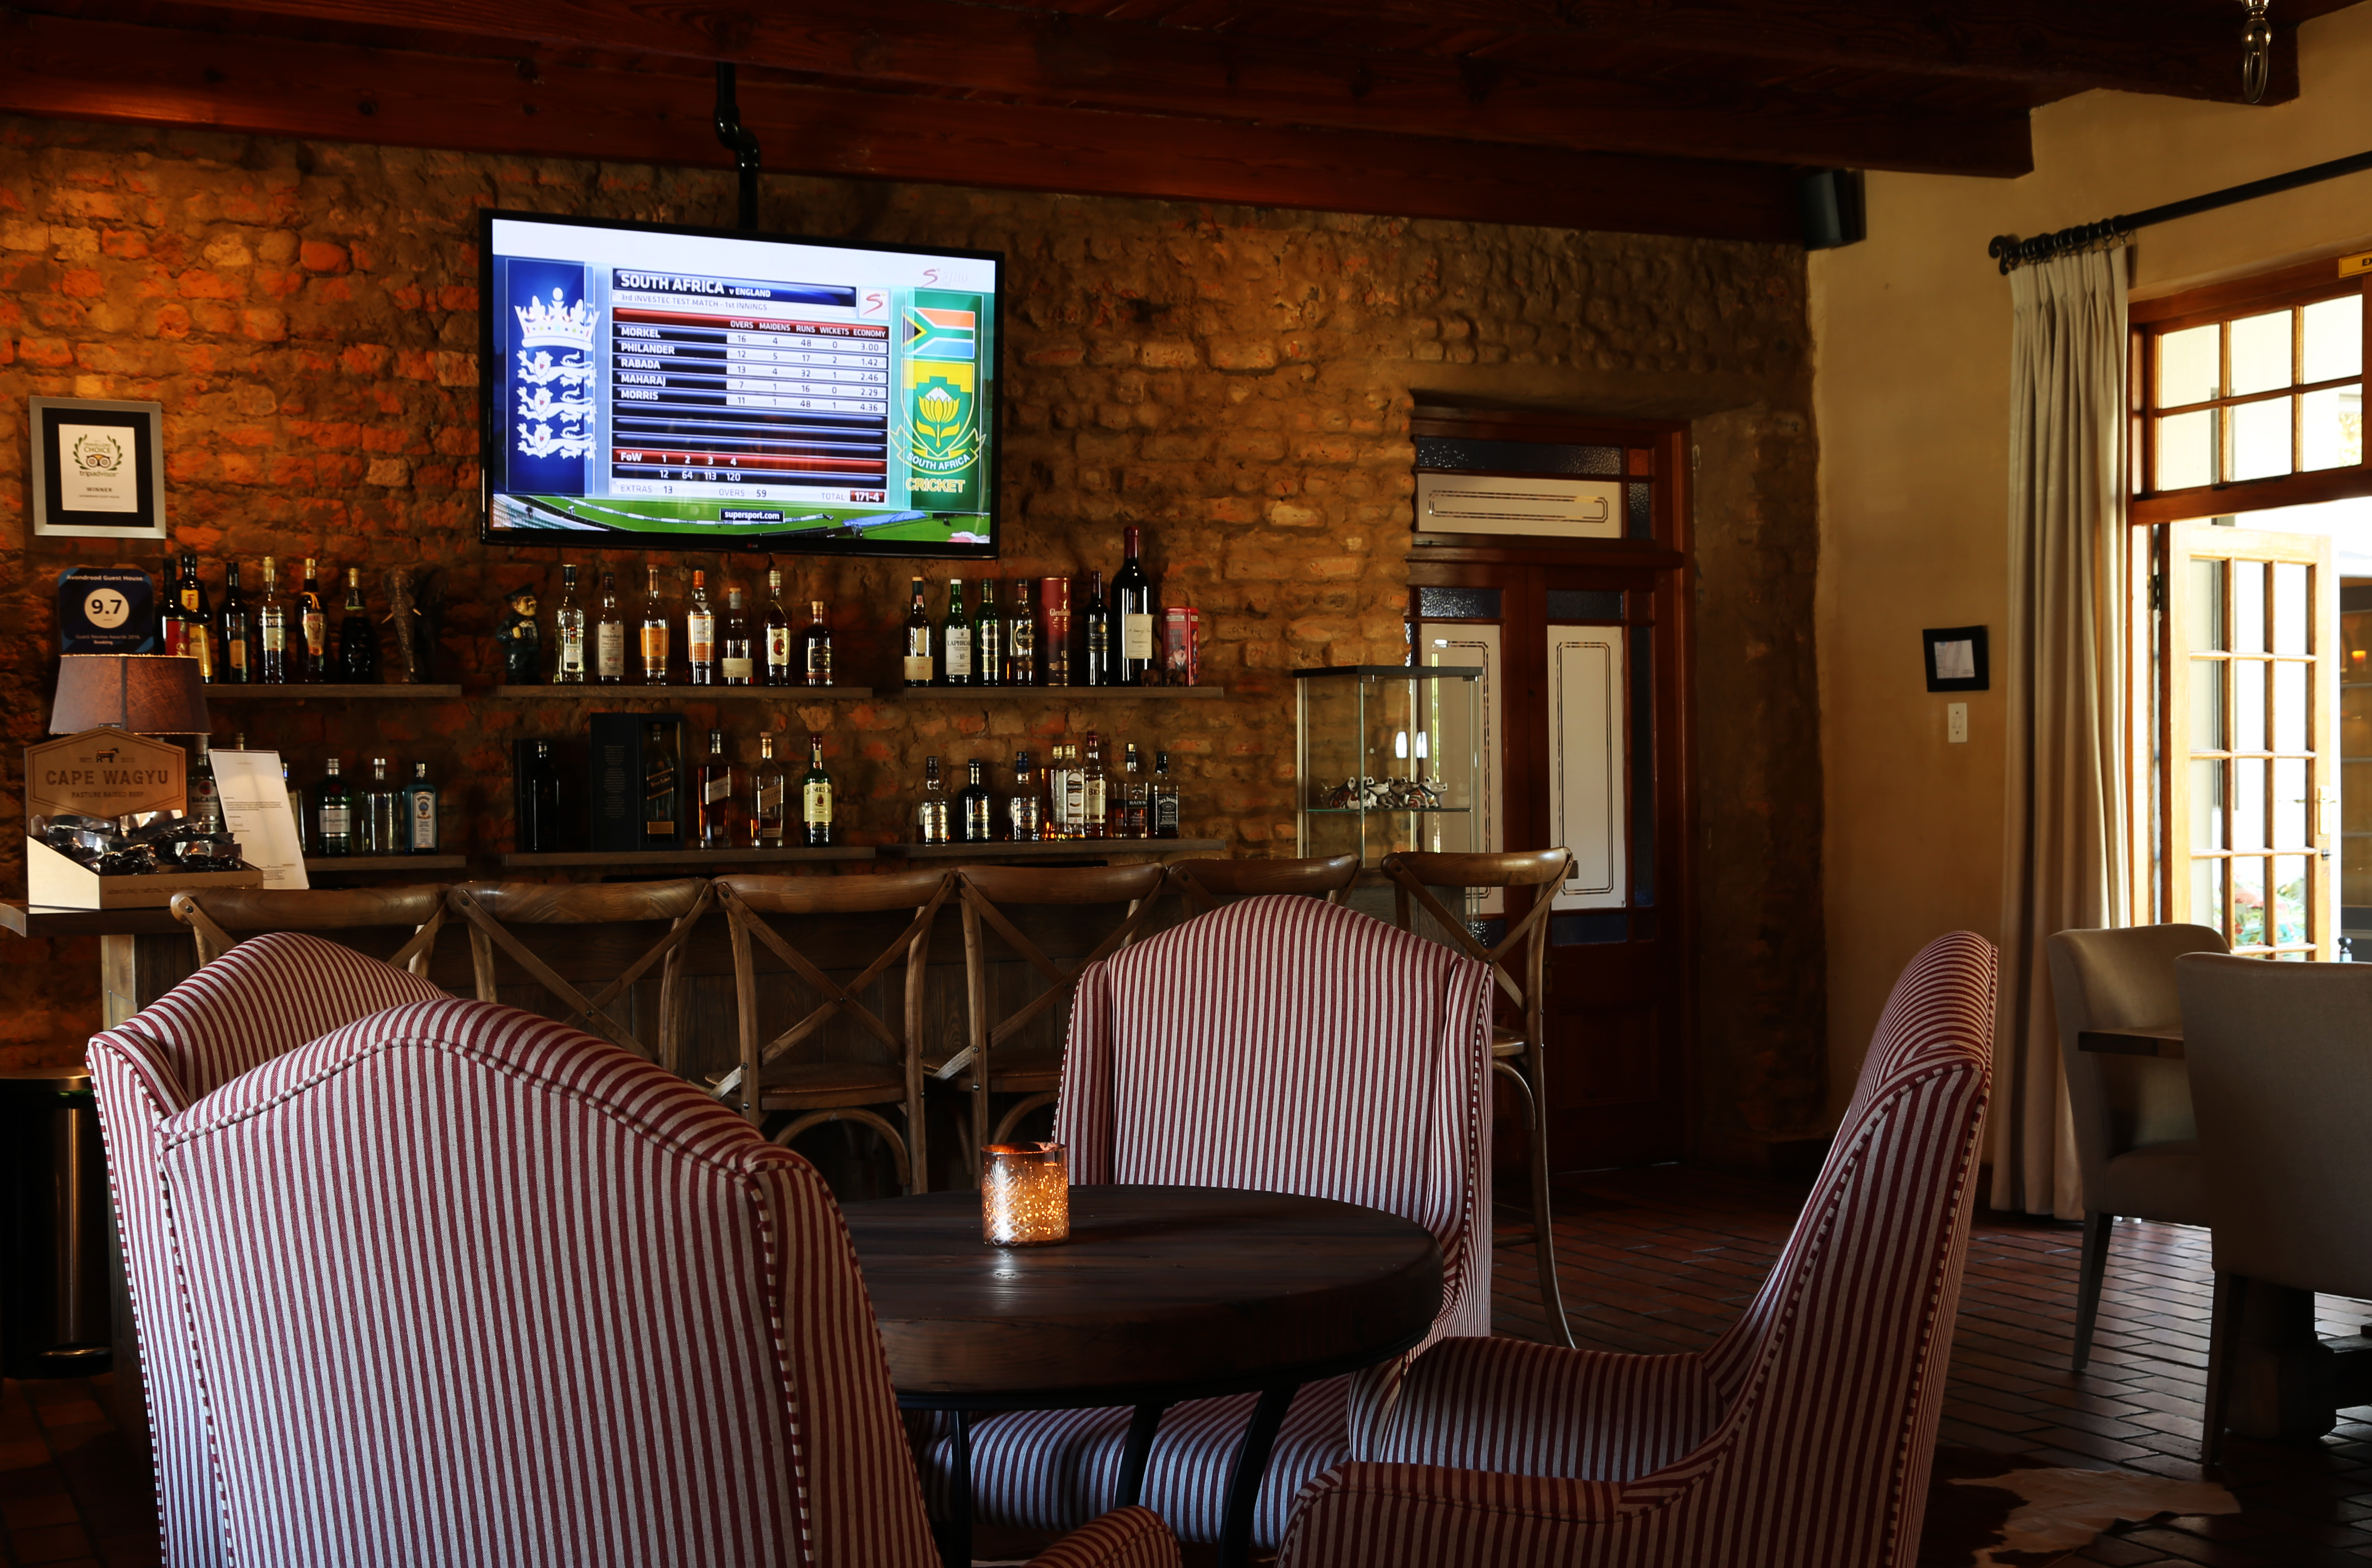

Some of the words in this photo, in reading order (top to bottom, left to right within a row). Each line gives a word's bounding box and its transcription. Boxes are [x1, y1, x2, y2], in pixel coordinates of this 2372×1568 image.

[620, 274, 669, 290] SOUTH
[672, 278, 725, 294] AFRICA
[735, 287, 771, 298] ENGLAND
[634, 294, 670, 304] INVESTEC
[673, 297, 690, 306] TEST
[692, 299, 718, 307] MATCH
[736, 302, 767, 311] INNINGS
[621, 327, 660, 338] MORKEL
[730, 320, 753, 329] OVERS
[759, 321, 791, 332] MAIDENS
[796, 324, 815, 333] RUNS
[820, 326, 849, 336] WICKETS
[853, 328, 886, 339] ECONOMY
[621, 342, 675, 354] PHILANDER
[621, 358, 660, 369] RABADA
[621, 374, 666, 387] MAHARAJ
[621, 390, 659, 400] MORRIS
[620, 452, 642, 462] FoW
[662, 454, 666, 463] 1
[685, 455, 691, 464] 2
[708, 456, 713, 465] 3
[730, 457, 736, 466] 4
[907, 452, 936, 470] SOUTH
[938, 453, 970, 470] AFRICA
[660, 469, 669, 478] 12
[682, 471, 693, 479] 64
[704, 472, 717, 481] 113
[726, 472, 740, 482] 120
[906, 477, 966, 493] CRICKET
[621, 485, 652, 493] EXTRAS
[719, 488, 745, 497] OVERS
[855, 492, 880, 502] 171-4
[725, 511, 780, 521] supersport.com
[91, 599, 122, 614] 9.7
[46, 770, 94, 785] CAPE
[103, 770, 168, 785] WAGYU
